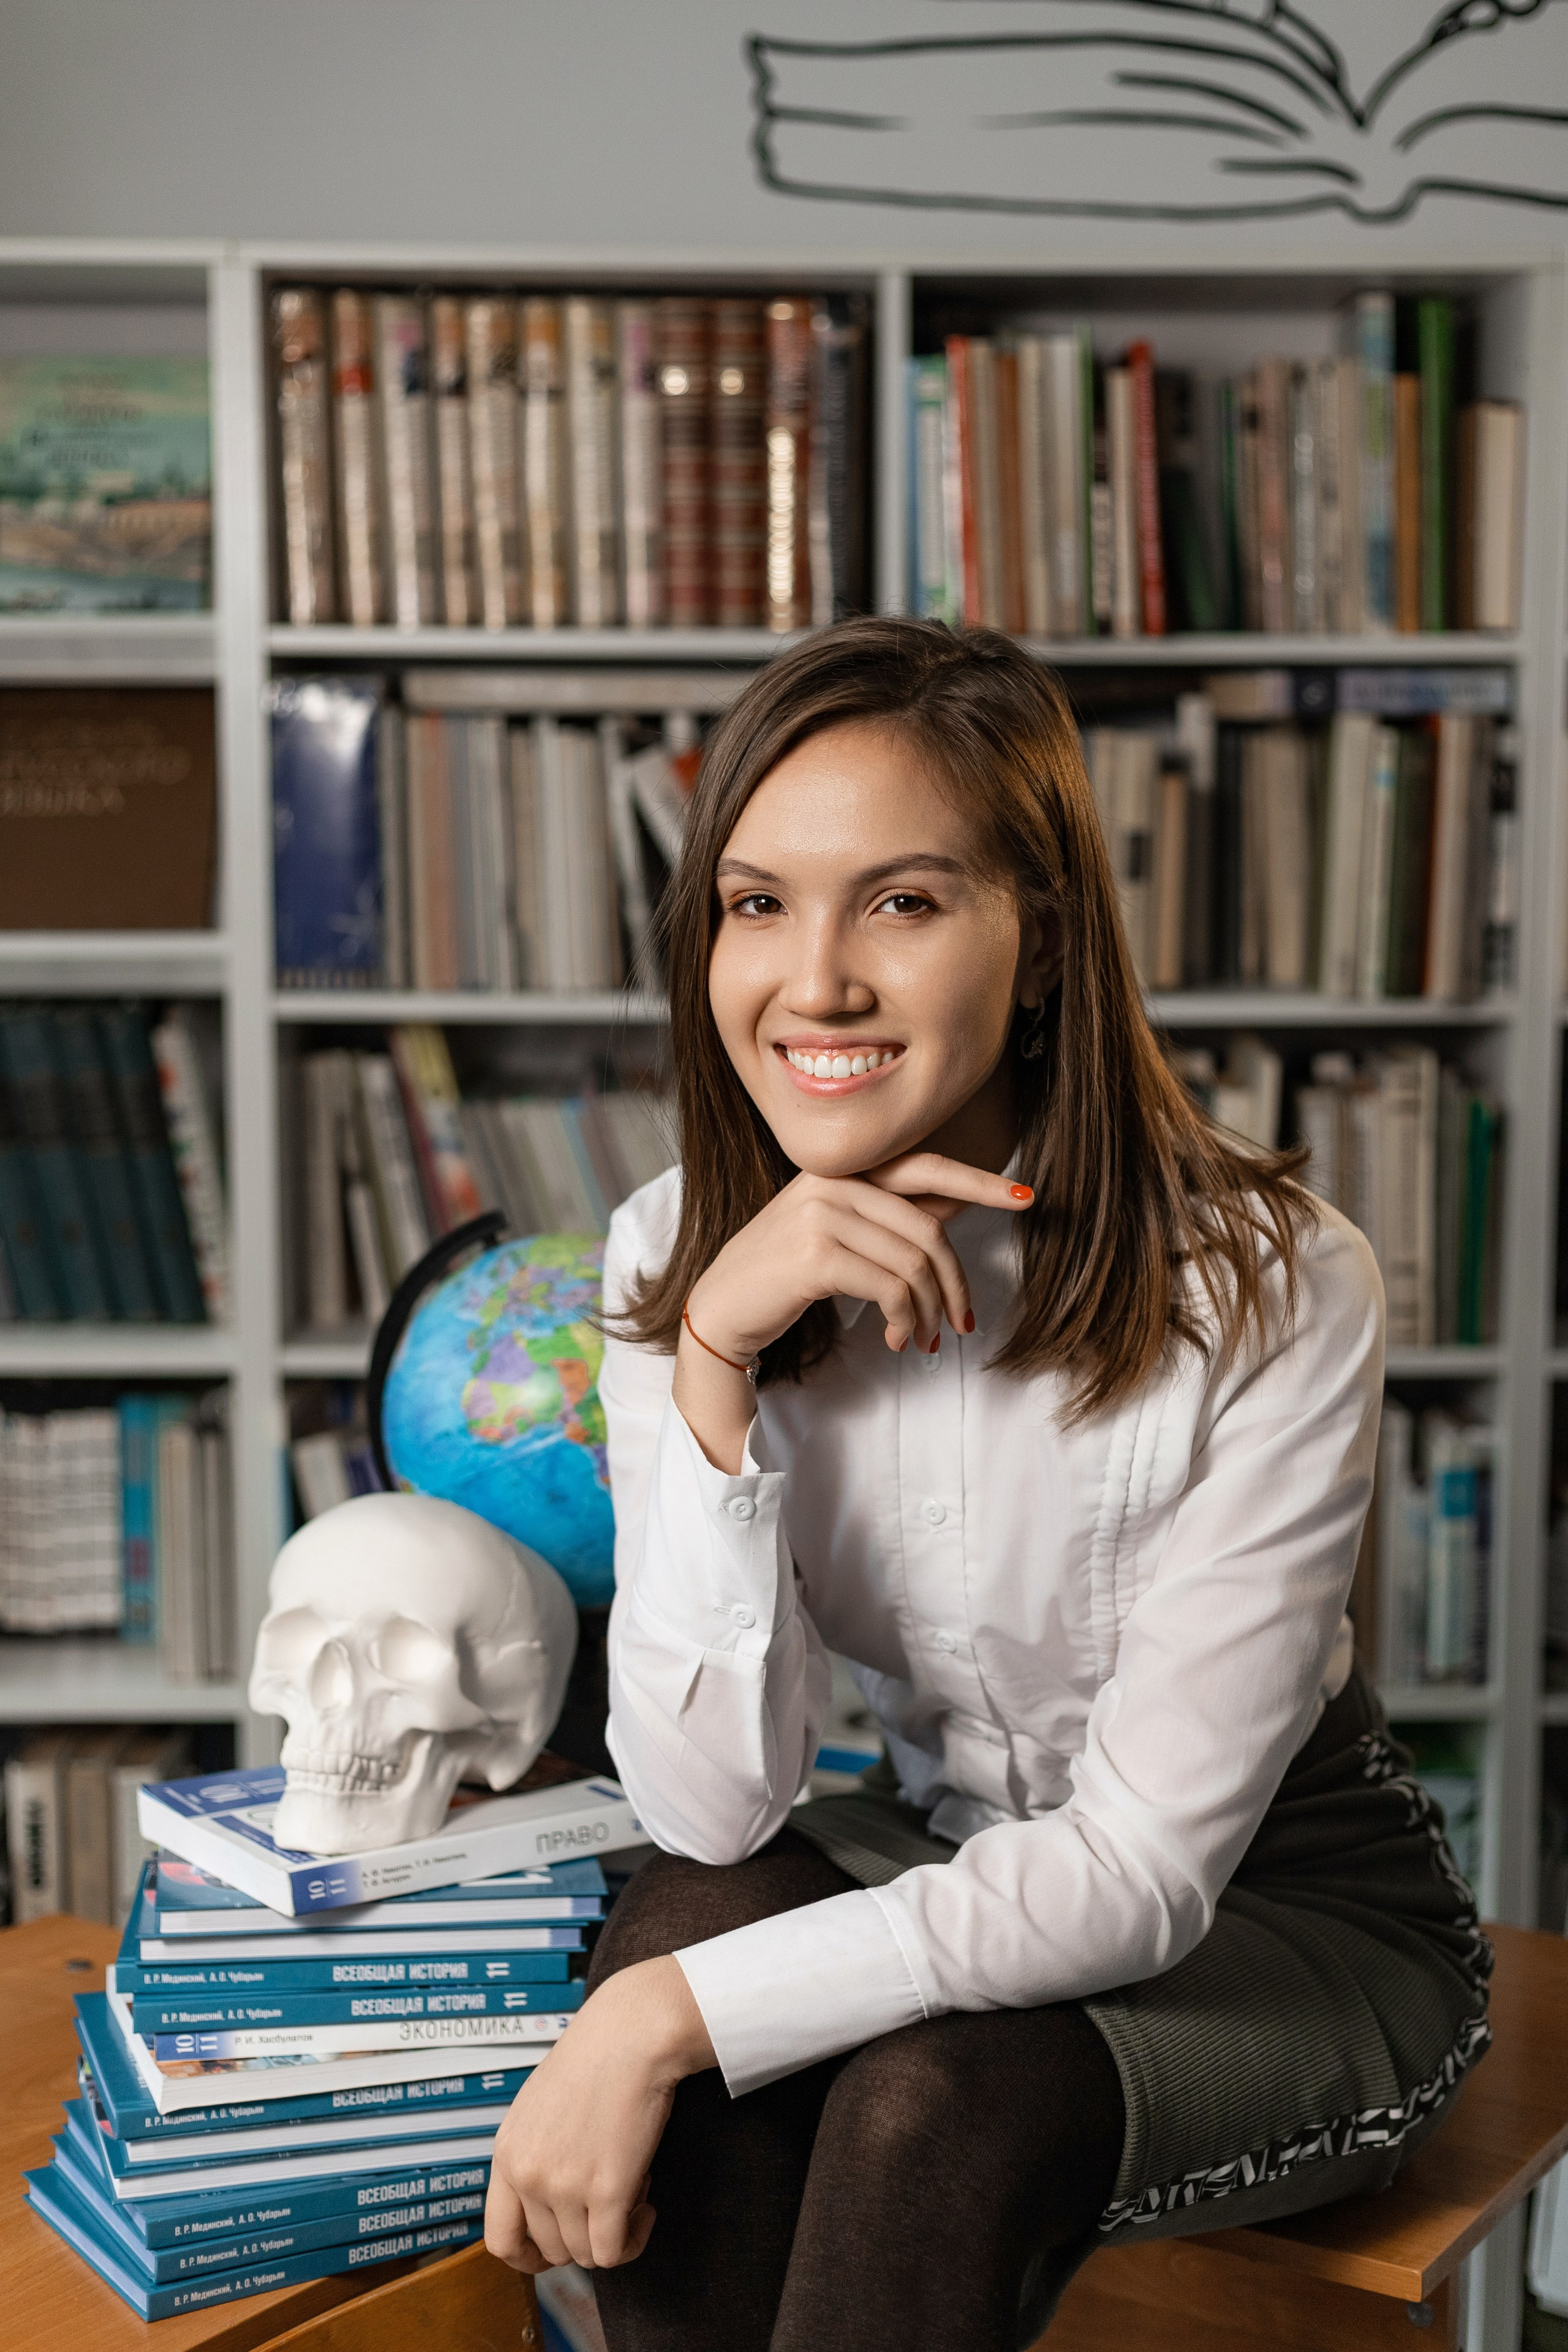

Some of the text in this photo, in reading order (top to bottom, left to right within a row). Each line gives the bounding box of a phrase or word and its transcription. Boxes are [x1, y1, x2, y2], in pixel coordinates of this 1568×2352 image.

[535, 1821, 610, 1855] ПРАВО
[307, 1880, 326, 1900] 10
[328, 1879, 346, 1894] 11
[144, 1974, 152, 1985] В.
[153, 1973, 160, 1984] Р.
[209, 1972, 217, 1983] А.
[219, 1972, 227, 1982] О.
[333, 1962, 469, 1982] ВСЕОБЩАЯ ИСТОРИЯ
[486, 1962, 510, 1979] 11
[351, 1994, 486, 2016] ВСЕОБЩАЯ ИСТОРИЯ
[503, 1992, 527, 2009] 11
[162, 2013, 170, 2024] В.
[171, 2012, 178, 2023] Р.
[227, 2010, 236, 2020] А.
[237, 2009, 246, 2019] О.
[258, 2034, 313, 2045] Хасбулатов
[399, 2018, 525, 2041] ЭКОНОМИКА
[175, 2034, 195, 2053] 10
[200, 2035, 218, 2051] 11
[481, 2073, 505, 2090] 11
[333, 2078, 465, 2108] ВСЕОБЩАЯ ИСТОРИЯ
[145, 2117, 153, 2128] В.
[154, 2116, 162, 2127] Р.
[210, 2110, 219, 2120] А.
[220, 2108, 228, 2119] О.
[358, 2168, 484, 2205] ВСЕОБЩАЯ ИСТОРИЯ
[175, 2208, 291, 2236] В. Р. Мединский, А. О. Чубарьян
[358, 2194, 482, 2233] ВСЕОБЩАЯ ИСТОРИЯ
[349, 2221, 469, 2264] ВСЕОБЩАЯ ИСТОРИЯ
[180, 2237, 294, 2269] В. Р. Мединский, А. О. Чубарьян
[175, 2271, 285, 2307] В. Р. Мединский, А. О. Чубарьян
